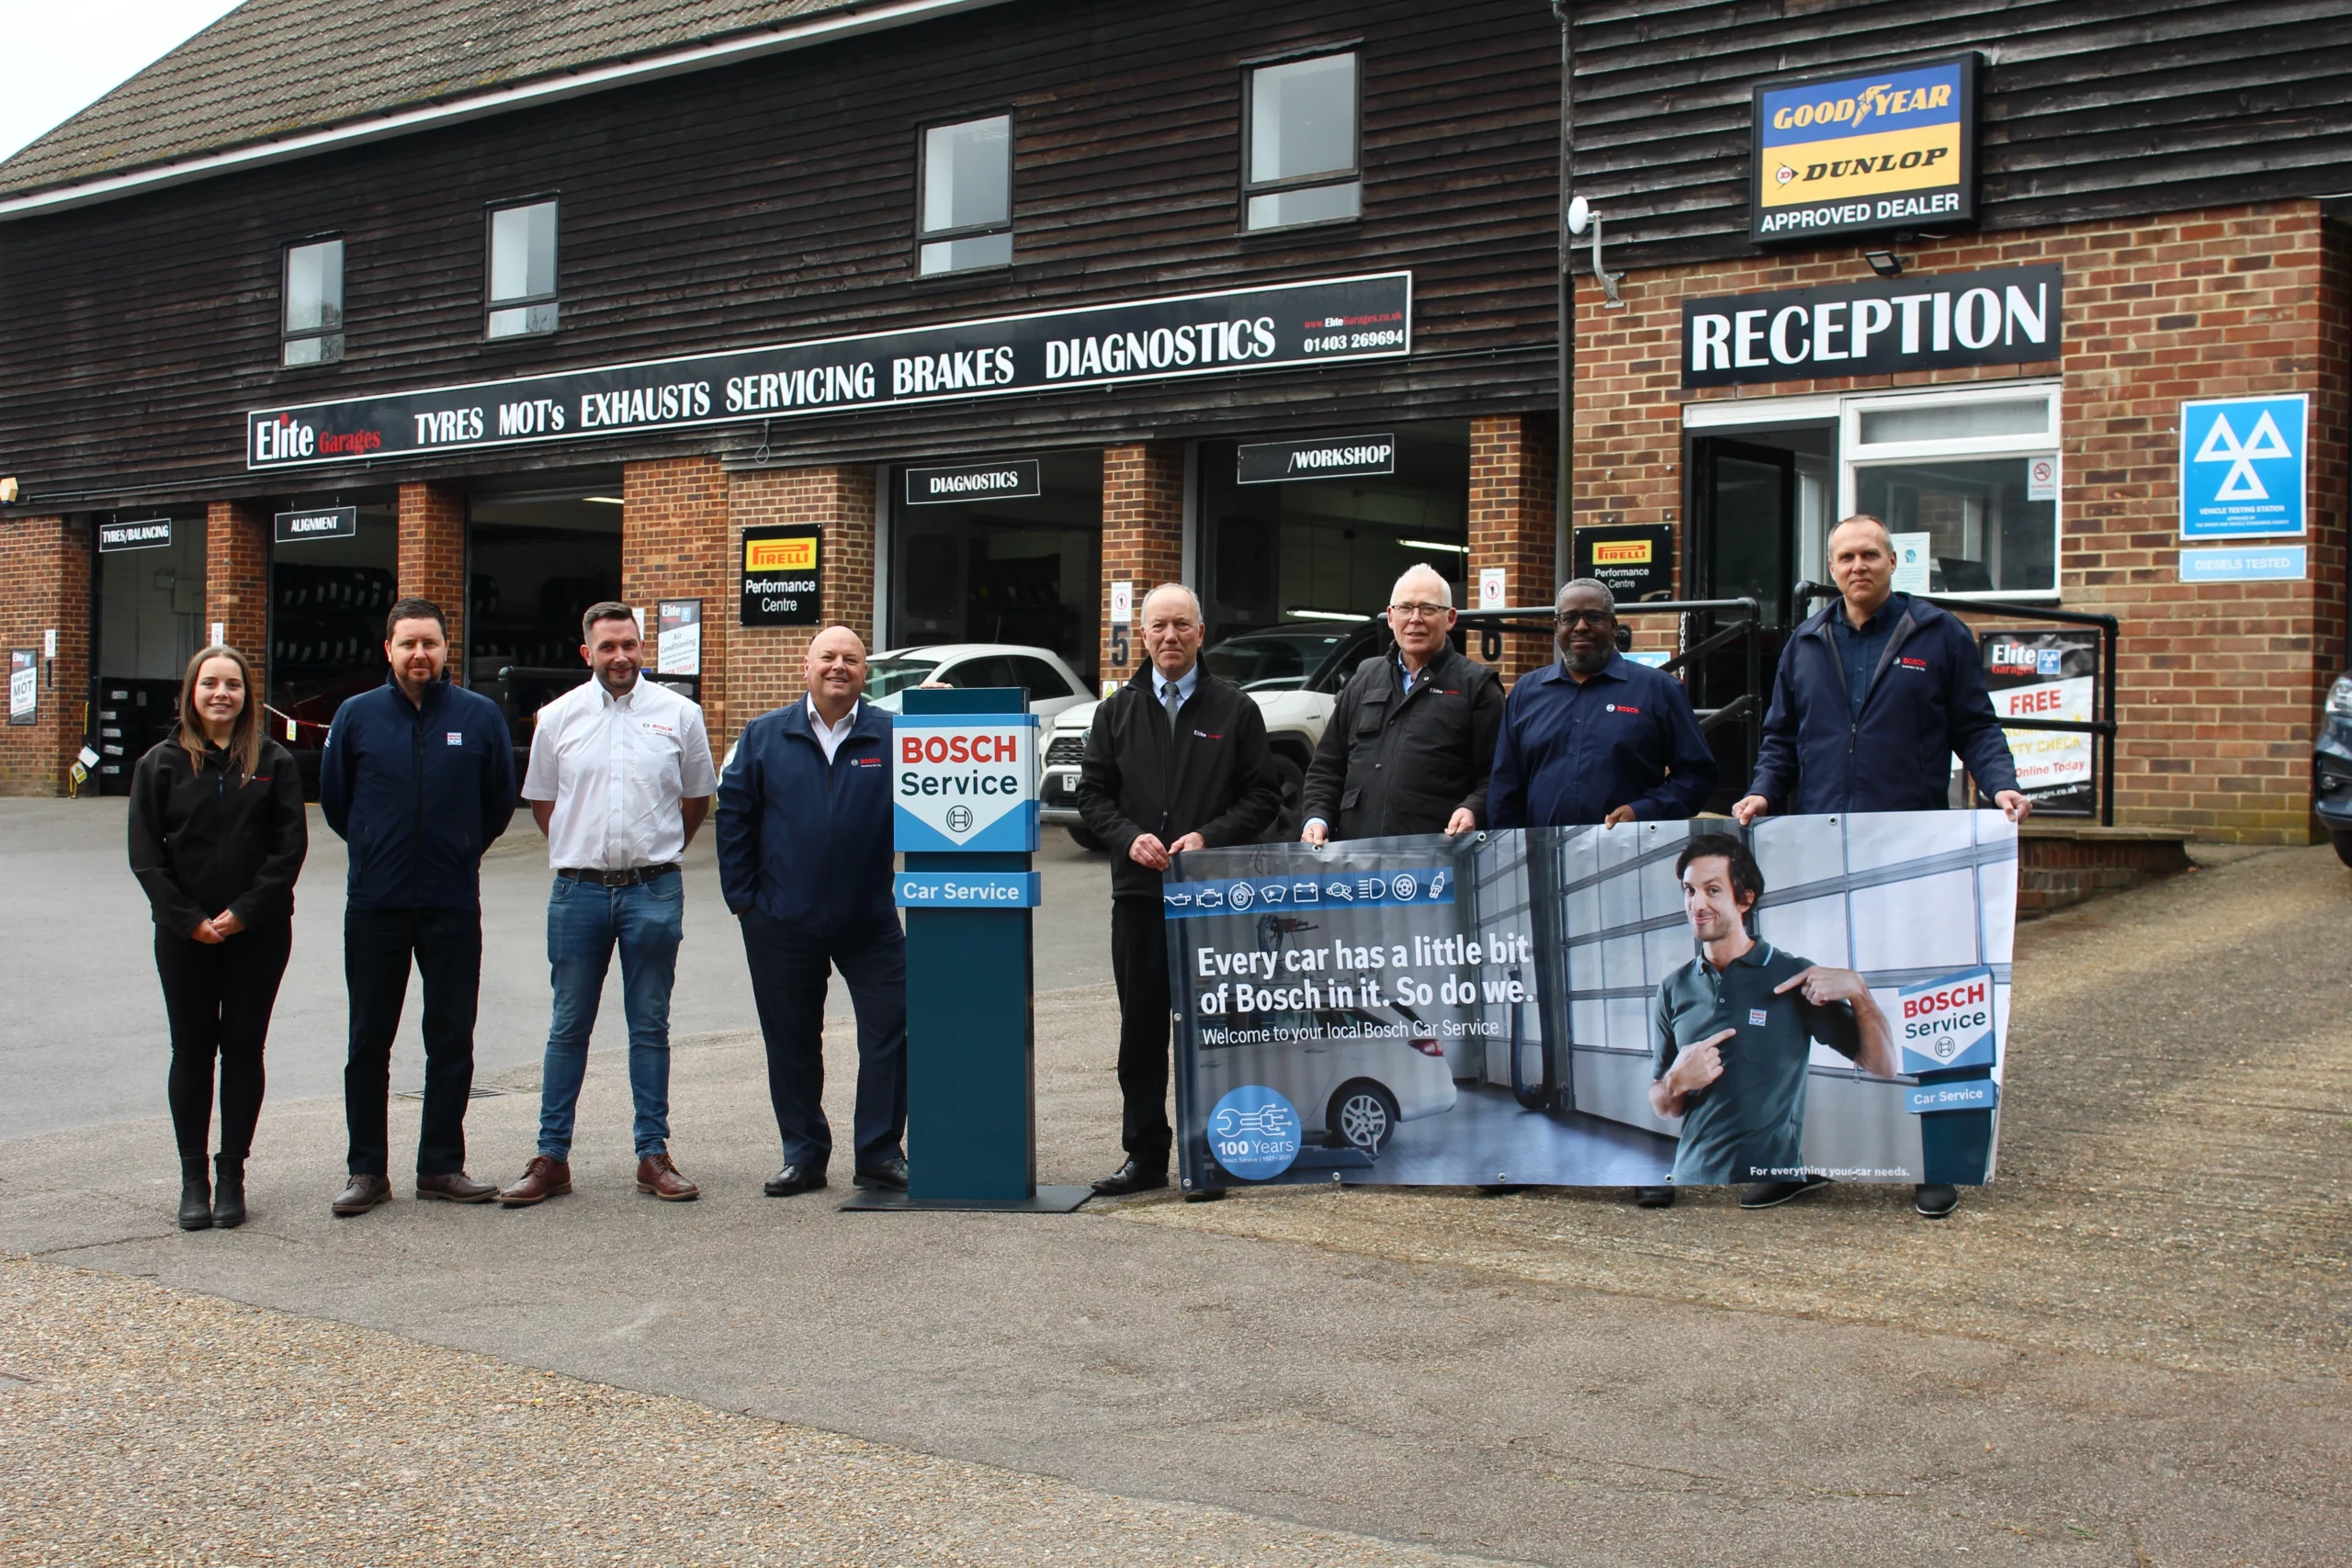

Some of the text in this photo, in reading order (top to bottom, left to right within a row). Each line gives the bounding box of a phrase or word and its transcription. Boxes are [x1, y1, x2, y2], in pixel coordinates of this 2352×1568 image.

[1803, 147, 1949, 182] DUNLOP
[1760, 193, 1959, 232] APPROVED DEALER
[1692, 283, 2047, 371] RECEPTION
[1304, 329, 1404, 353] 01403 269694
[256, 316, 1276, 461] Elite Garages TYRES MOT's EXHAUSTS SERVICING BRAKES DIAGNOSTICS
[930, 470, 1018, 493] DIAGNOSTICS
[2199, 507, 2227, 515] VEHICLE
[2256, 504, 2285, 513] STATION
[290, 515, 338, 533] ALIGNMENT
[102, 525, 169, 544] TYRES/BALANCING
[752, 544, 809, 565] PIRELLI
[1598, 545, 1645, 559] PIRELLI
[2195, 557, 2290, 570] DIESELS TESTED
[1594, 568, 1649, 578] Performance
[745, 579, 816, 593] Performance
[1608, 579, 1635, 588] Centre
[662, 604, 681, 616] Elite
[762, 597, 797, 612] Centre
[673, 632, 683, 640] Air
[661, 638, 696, 653] Conditioning
[1112, 625, 1128, 667] 5
[1992, 641, 2036, 664] Elite
[1992, 665, 2036, 676] Garages
[13, 680, 33, 697] MOT
[1617, 705, 1639, 714] BOSCH
[2010, 689, 2062, 716] FREE
[652, 724, 673, 732] BOSCH
[902, 735, 1016, 763] BOSCH
[2037, 735, 2082, 752] CHECK
[2053, 761, 2085, 773] Today
[900, 770, 1018, 795] Service
[903, 882, 1019, 900] Car Service
[1197, 932, 1530, 979] Every car has a little bit
[1201, 974, 1534, 1015] of Bosch in it. So do we.
[1904, 982, 1984, 1019] BOSCH
[1203, 1018, 1499, 1045] Welcome to your local Bosch Car Service
[1905, 1011, 1986, 1039] Service
[1914, 1089, 1984, 1105] Car Service
[1217, 1140, 1294, 1156] 100 Years
[1749, 1166, 1910, 1178] For everything your car needs.
